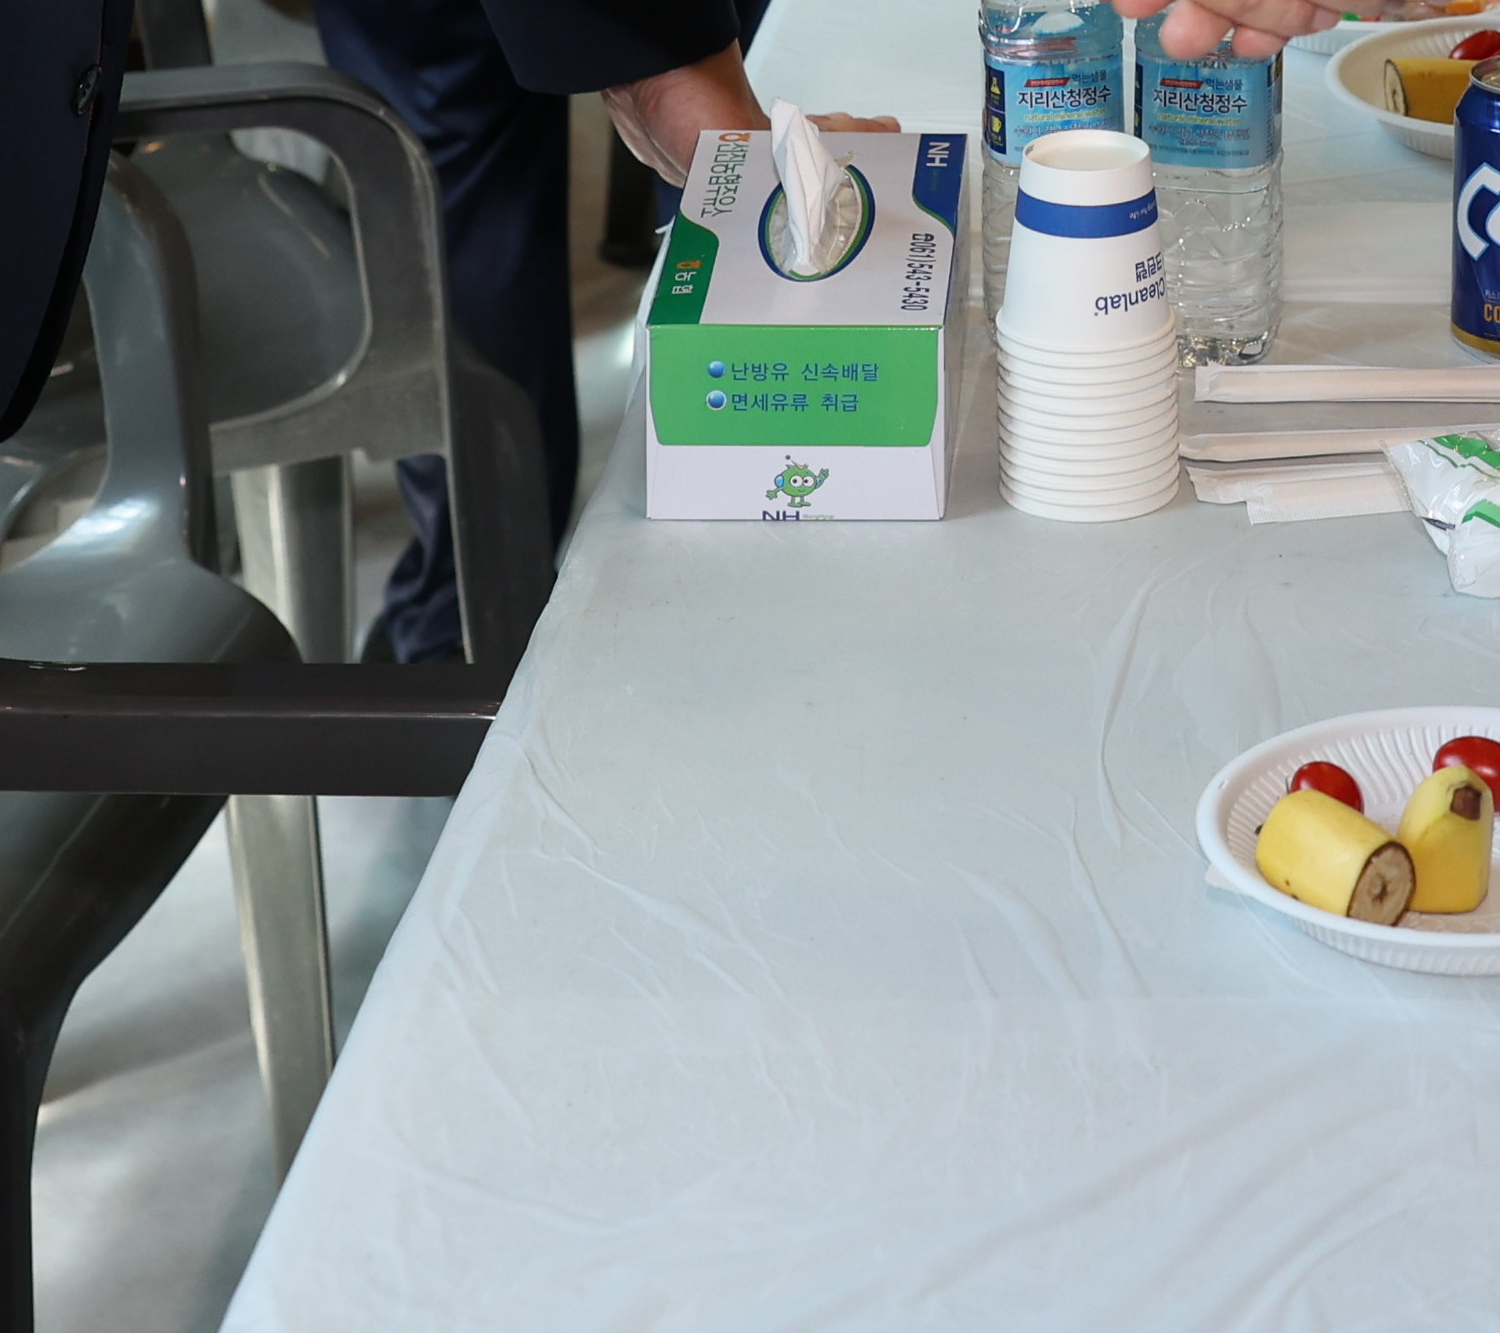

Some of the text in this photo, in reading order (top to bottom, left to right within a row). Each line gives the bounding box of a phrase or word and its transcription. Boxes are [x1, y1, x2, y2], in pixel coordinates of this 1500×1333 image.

[1017, 84, 1112, 109] 지리산청정수
[1153, 89, 1248, 114] 지리산청정수
[925, 141, 951, 168] NH
[701, 142, 750, 219] 선진농협주유소
[1134, 251, 1163, 283] 크린랩
[671, 270, 698, 295] 농협
[1094, 276, 1166, 316] Cleanlab
[731, 362, 879, 382] 난방유 신속배달
[731, 392, 860, 413] 면세유류 취급
[762, 509, 800, 521] NH
